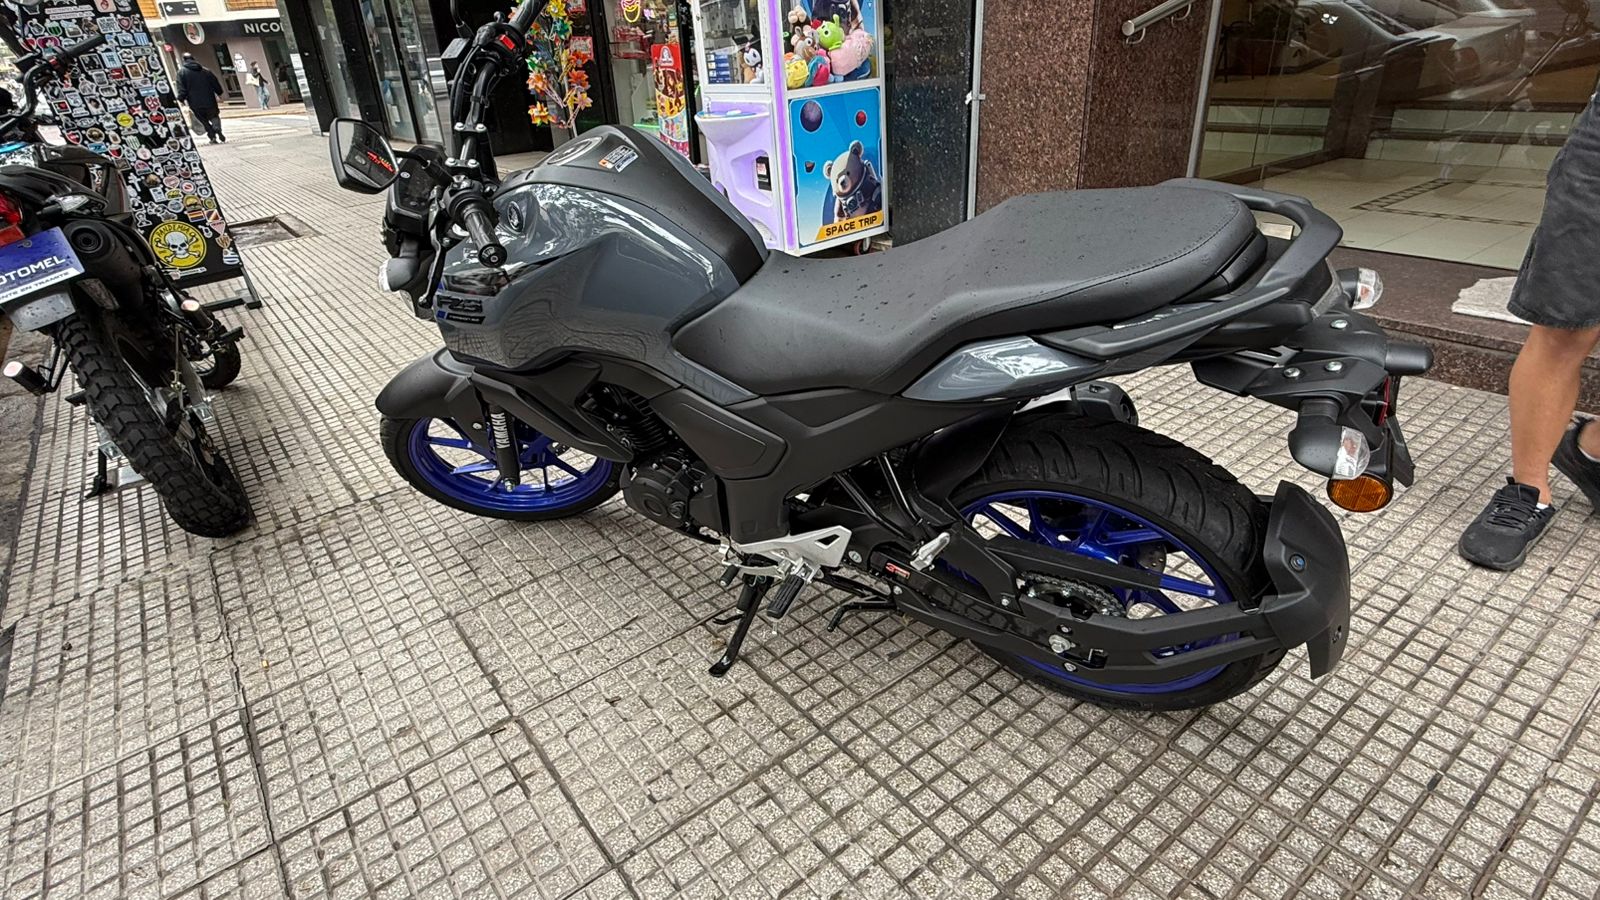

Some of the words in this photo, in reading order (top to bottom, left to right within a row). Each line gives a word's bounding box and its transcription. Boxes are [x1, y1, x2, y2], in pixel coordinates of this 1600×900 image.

[156, 224, 190, 237] PANDEMIA
[825, 221, 856, 236] SPACE
[858, 215, 878, 227] TRIP
[490, 412, 510, 449] YAMAHA
